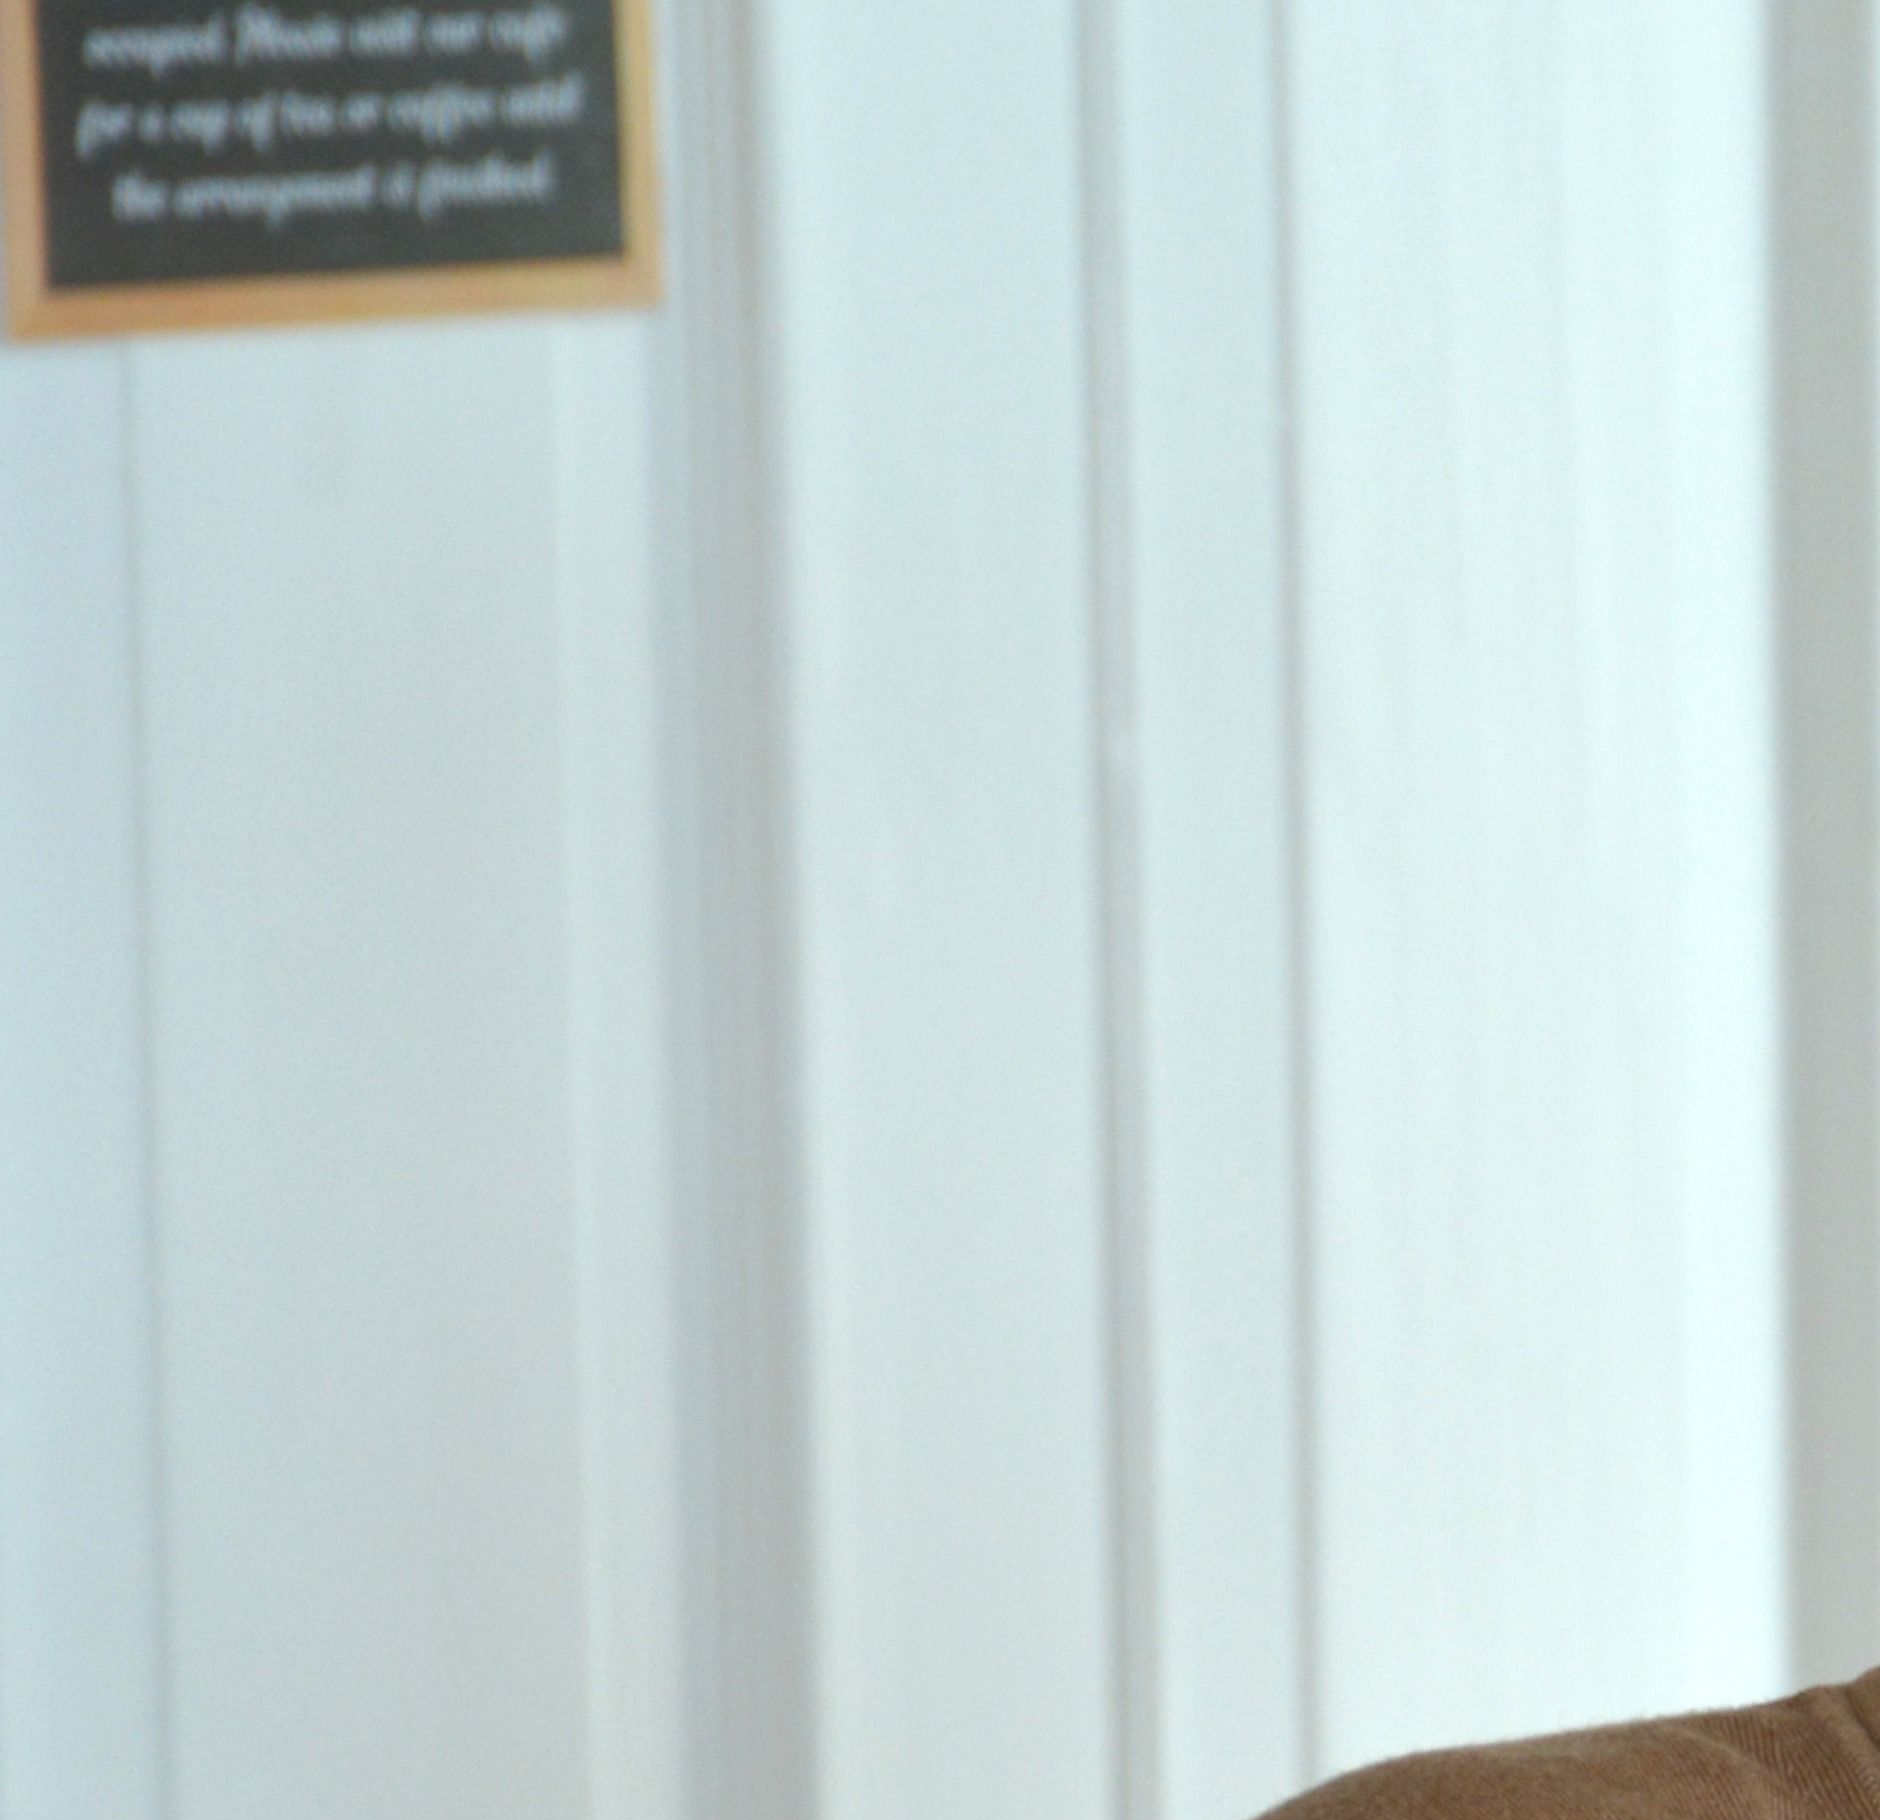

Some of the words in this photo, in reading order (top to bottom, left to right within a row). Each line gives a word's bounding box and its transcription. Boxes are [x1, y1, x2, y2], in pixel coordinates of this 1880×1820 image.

[74, 99, 133, 159] for
[235, 95, 274, 152] of
[387, 83, 495, 144] coffee
[112, 171, 166, 221] the
